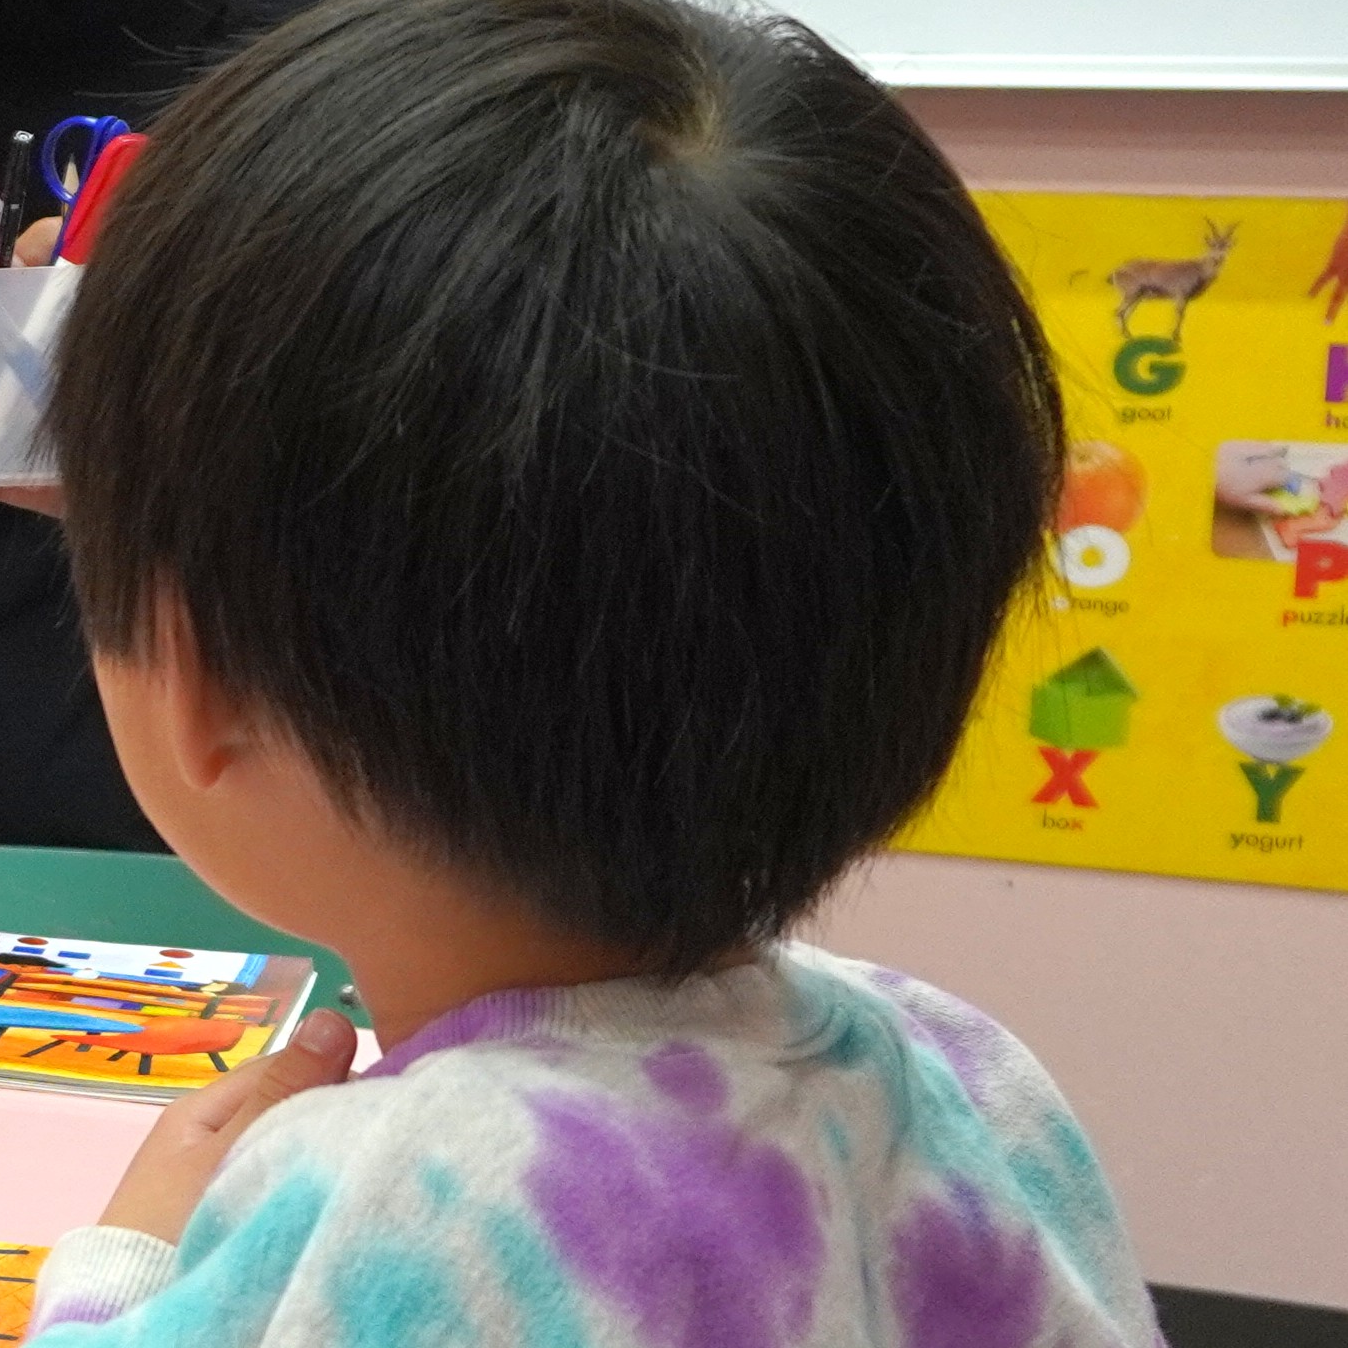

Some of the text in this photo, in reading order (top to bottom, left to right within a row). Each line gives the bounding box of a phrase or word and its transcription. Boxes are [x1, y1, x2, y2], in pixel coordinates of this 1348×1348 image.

[1113, 336, 1187, 396] G
[1119, 406, 1174, 425] goat
[1059, 523, 1132, 589] O
[1294, 539, 1348, 599] P
[1031, 746, 1099, 809] X
[1239, 762, 1306, 823] Y
[1041, 810, 1085, 831] box
[1229, 832, 1304, 852] yogurt
